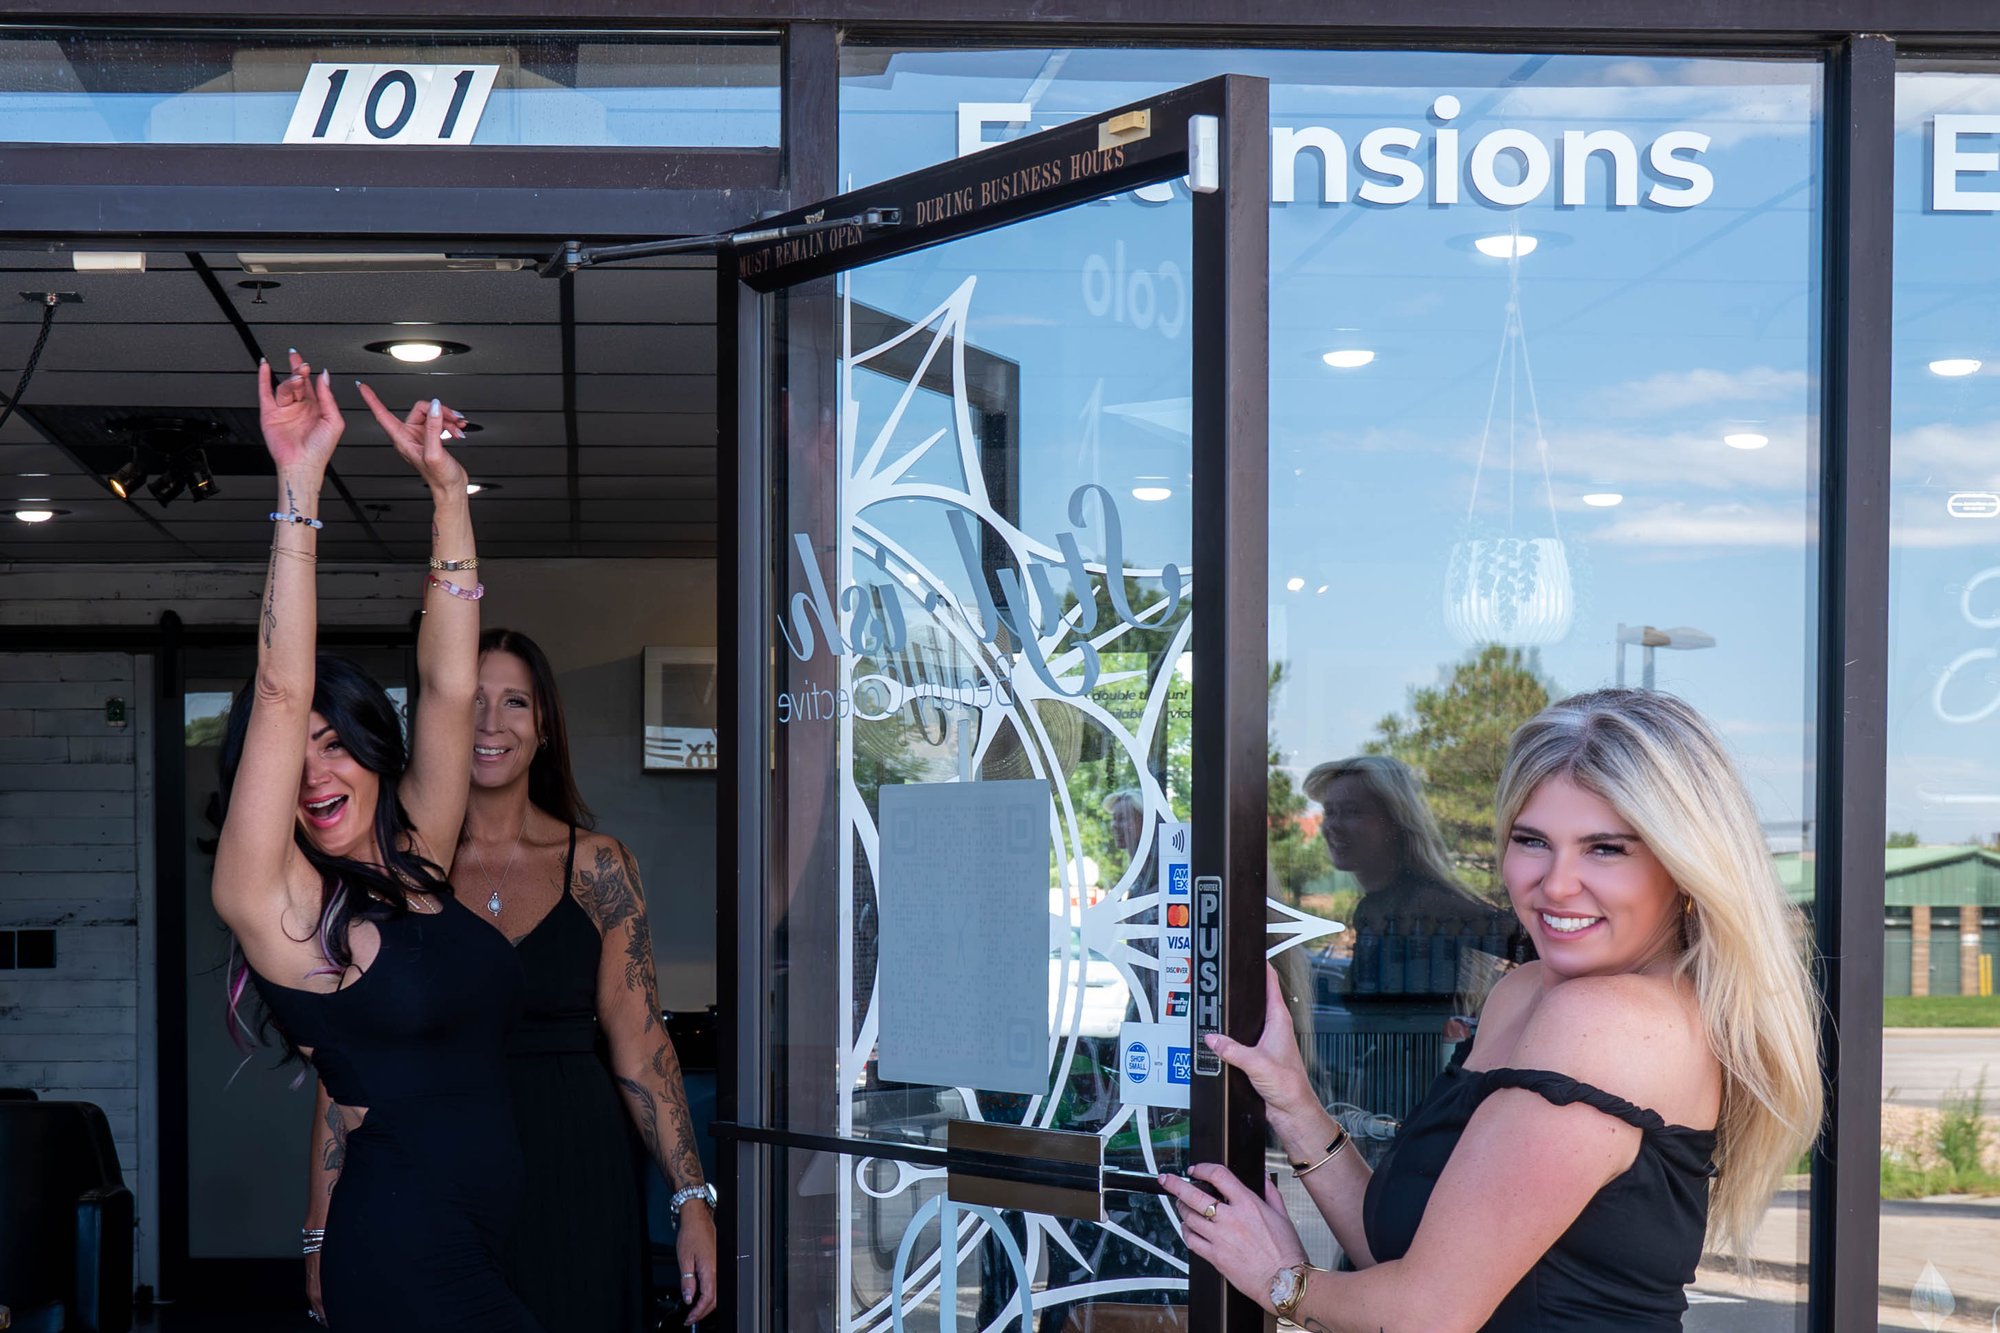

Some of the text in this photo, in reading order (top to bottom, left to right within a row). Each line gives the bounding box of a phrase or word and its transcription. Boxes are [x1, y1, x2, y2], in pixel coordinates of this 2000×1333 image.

[312, 69, 475, 139] 101
[959, 95, 1714, 208] Ensions
[738, 145, 1125, 277] MUST REMAIN OPEN DURING BUSINESS HOURS
[1167, 936, 1190, 949] VISA
[1199, 893, 1218, 1026] PUSH
[1128, 1062, 1146, 1070] SMALL
